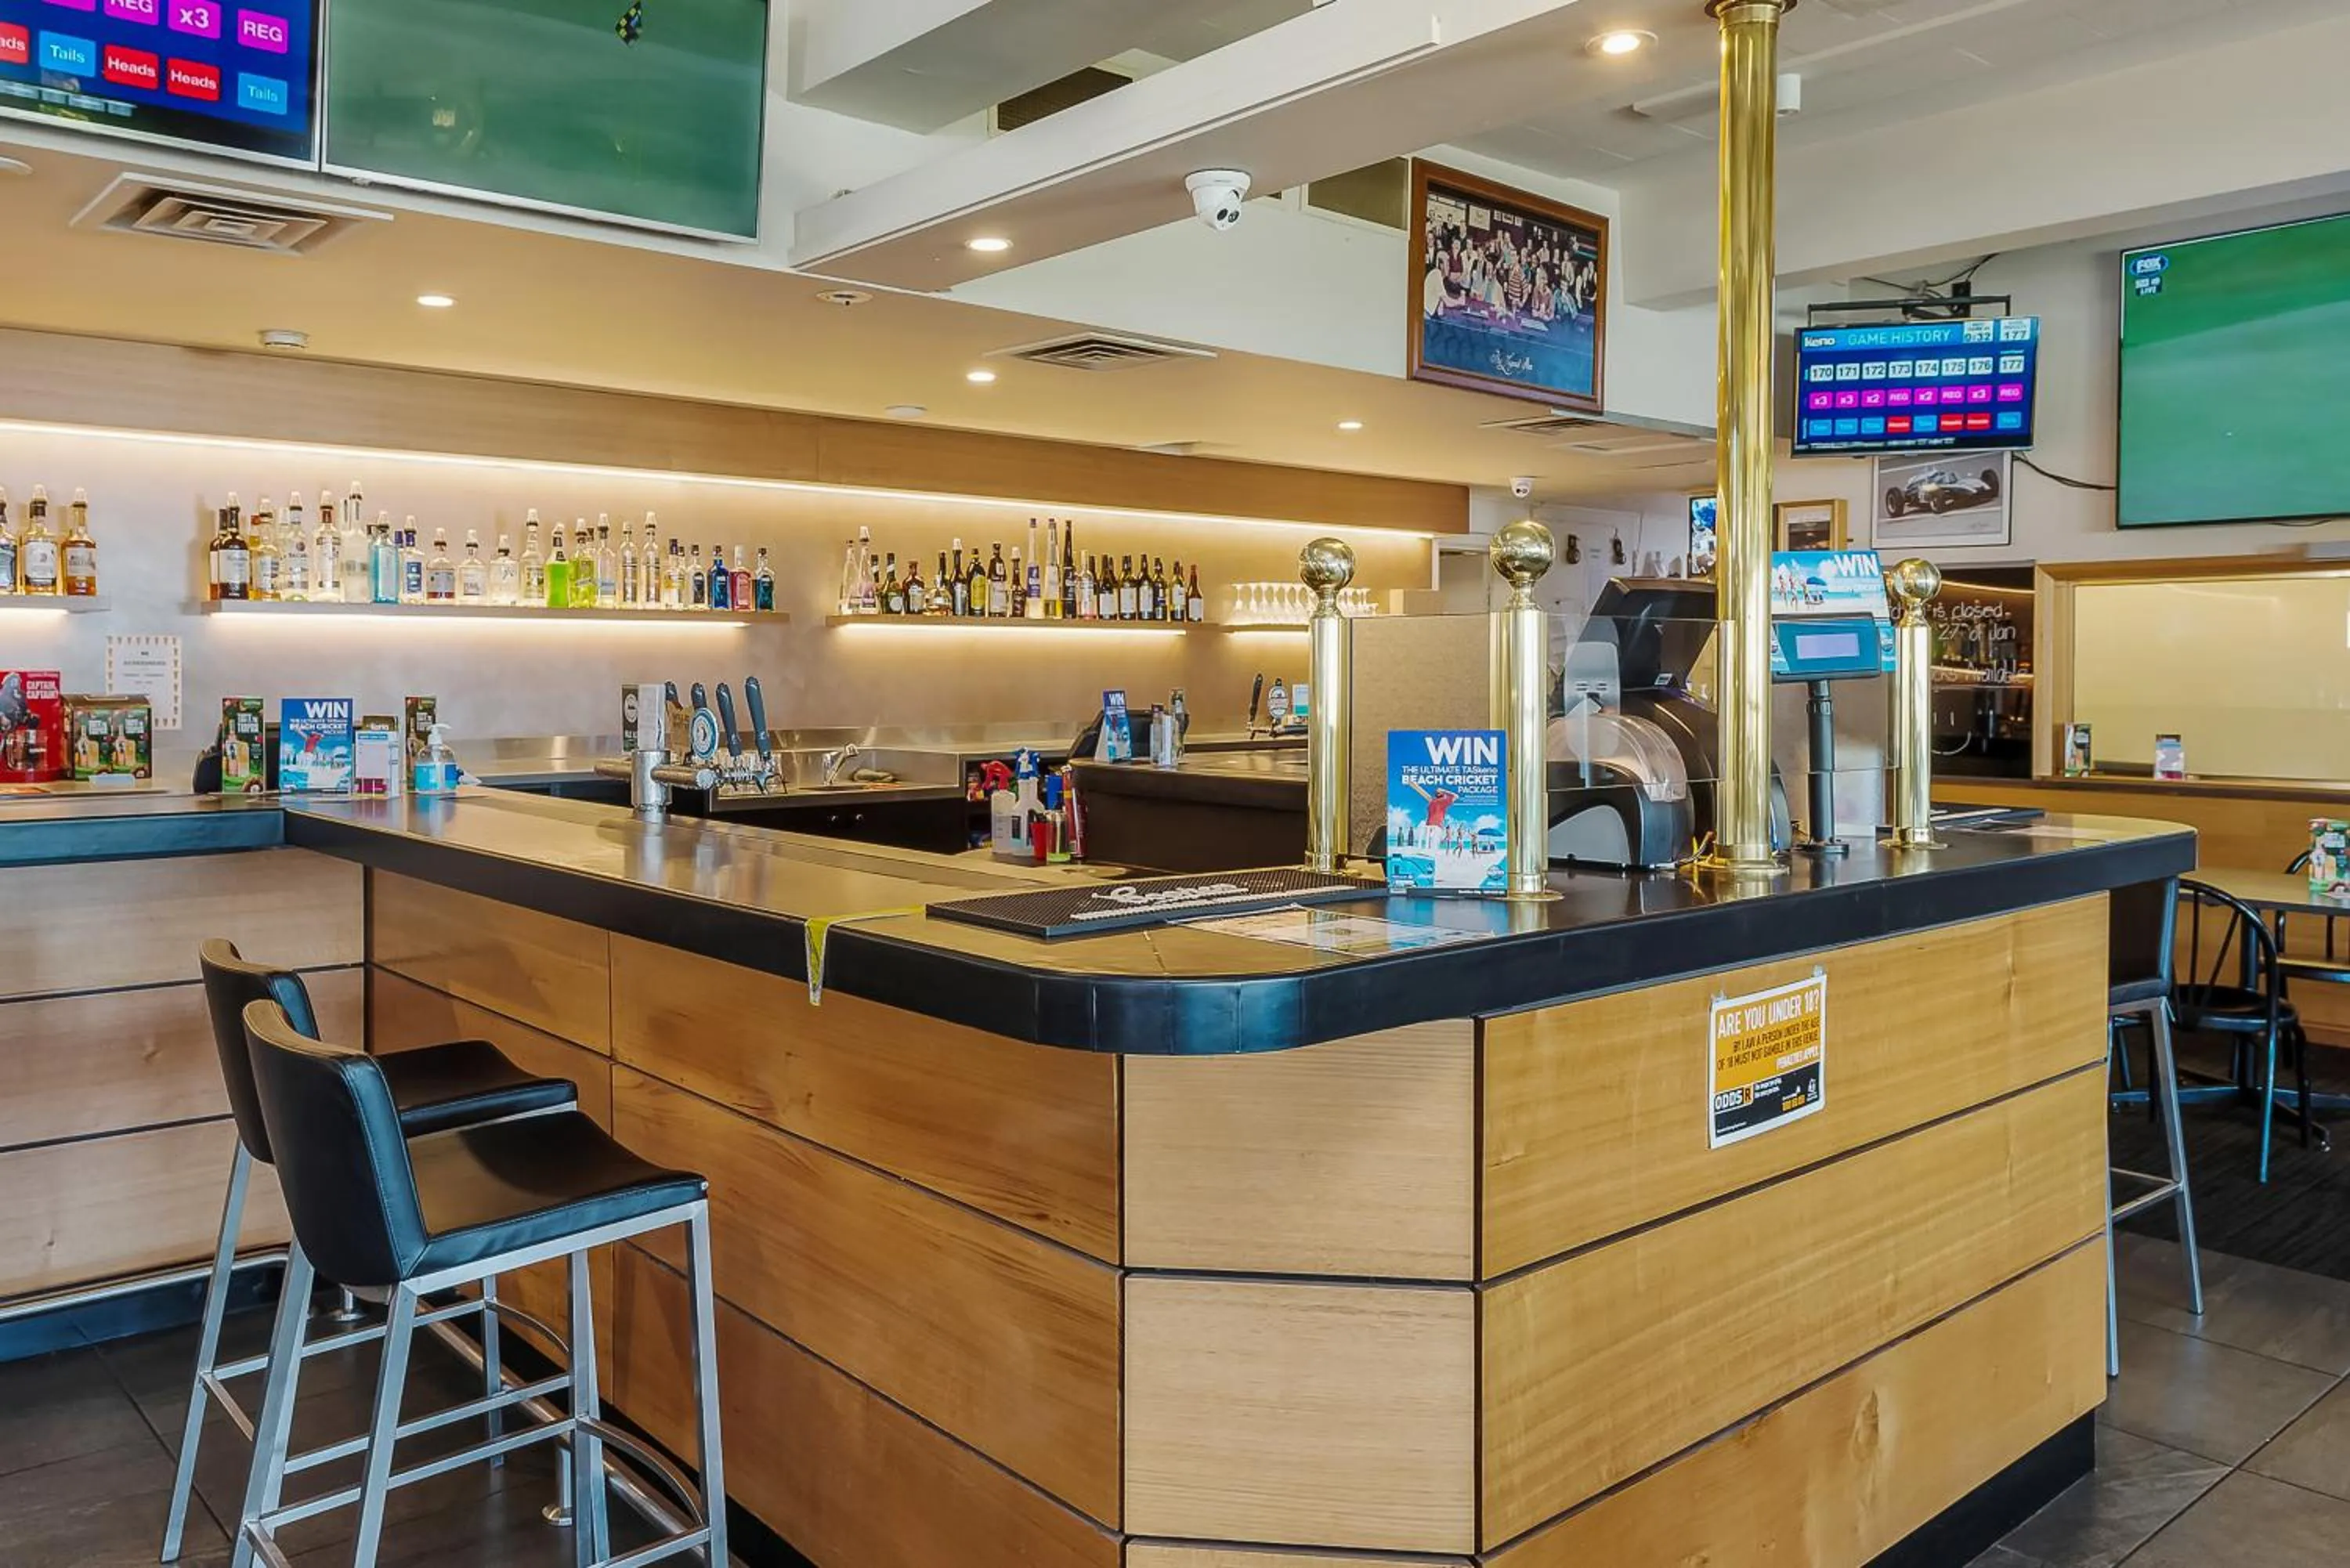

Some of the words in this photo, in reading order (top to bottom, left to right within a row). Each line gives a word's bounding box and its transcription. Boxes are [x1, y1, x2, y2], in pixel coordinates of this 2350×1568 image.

[179, 8, 209, 29] x3
[243, 20, 283, 43] REG
[49, 44, 85, 63] Tails
[107, 56, 156, 78] Heads
[170, 69, 217, 91] Heads
[247, 85, 280, 103] Tails
[1847, 333, 1888, 346] GAME
[1891, 329, 1951, 344] HISTORY
[1812, 367, 1832, 379] 170
[1839, 366, 1857, 378] 171
[1864, 365, 1884, 376] 172
[1890, 364, 1910, 374] 173
[1918, 363, 1937, 373] 174
[1944, 362, 1964, 372] 175
[1972, 360, 1990, 370] 176
[2002, 359, 2022, 370] 177
[1834, 554, 1878, 577] WIN
[304, 701, 349, 718] WIN
[1425, 737, 1498, 765] WIN
[1401, 765, 1419, 774] THE
[1420, 765, 1460, 774] ULTIMATE
[1401, 775, 1442, 785] BEACH
[1445, 775, 1498, 785] CRICKET
[1717, 1011, 1741, 1039] ARE
[1744, 1005, 1766, 1031] YOU
[1769, 995, 1801, 1024] UNDER
[1715, 1089, 1743, 1111] ODDS
